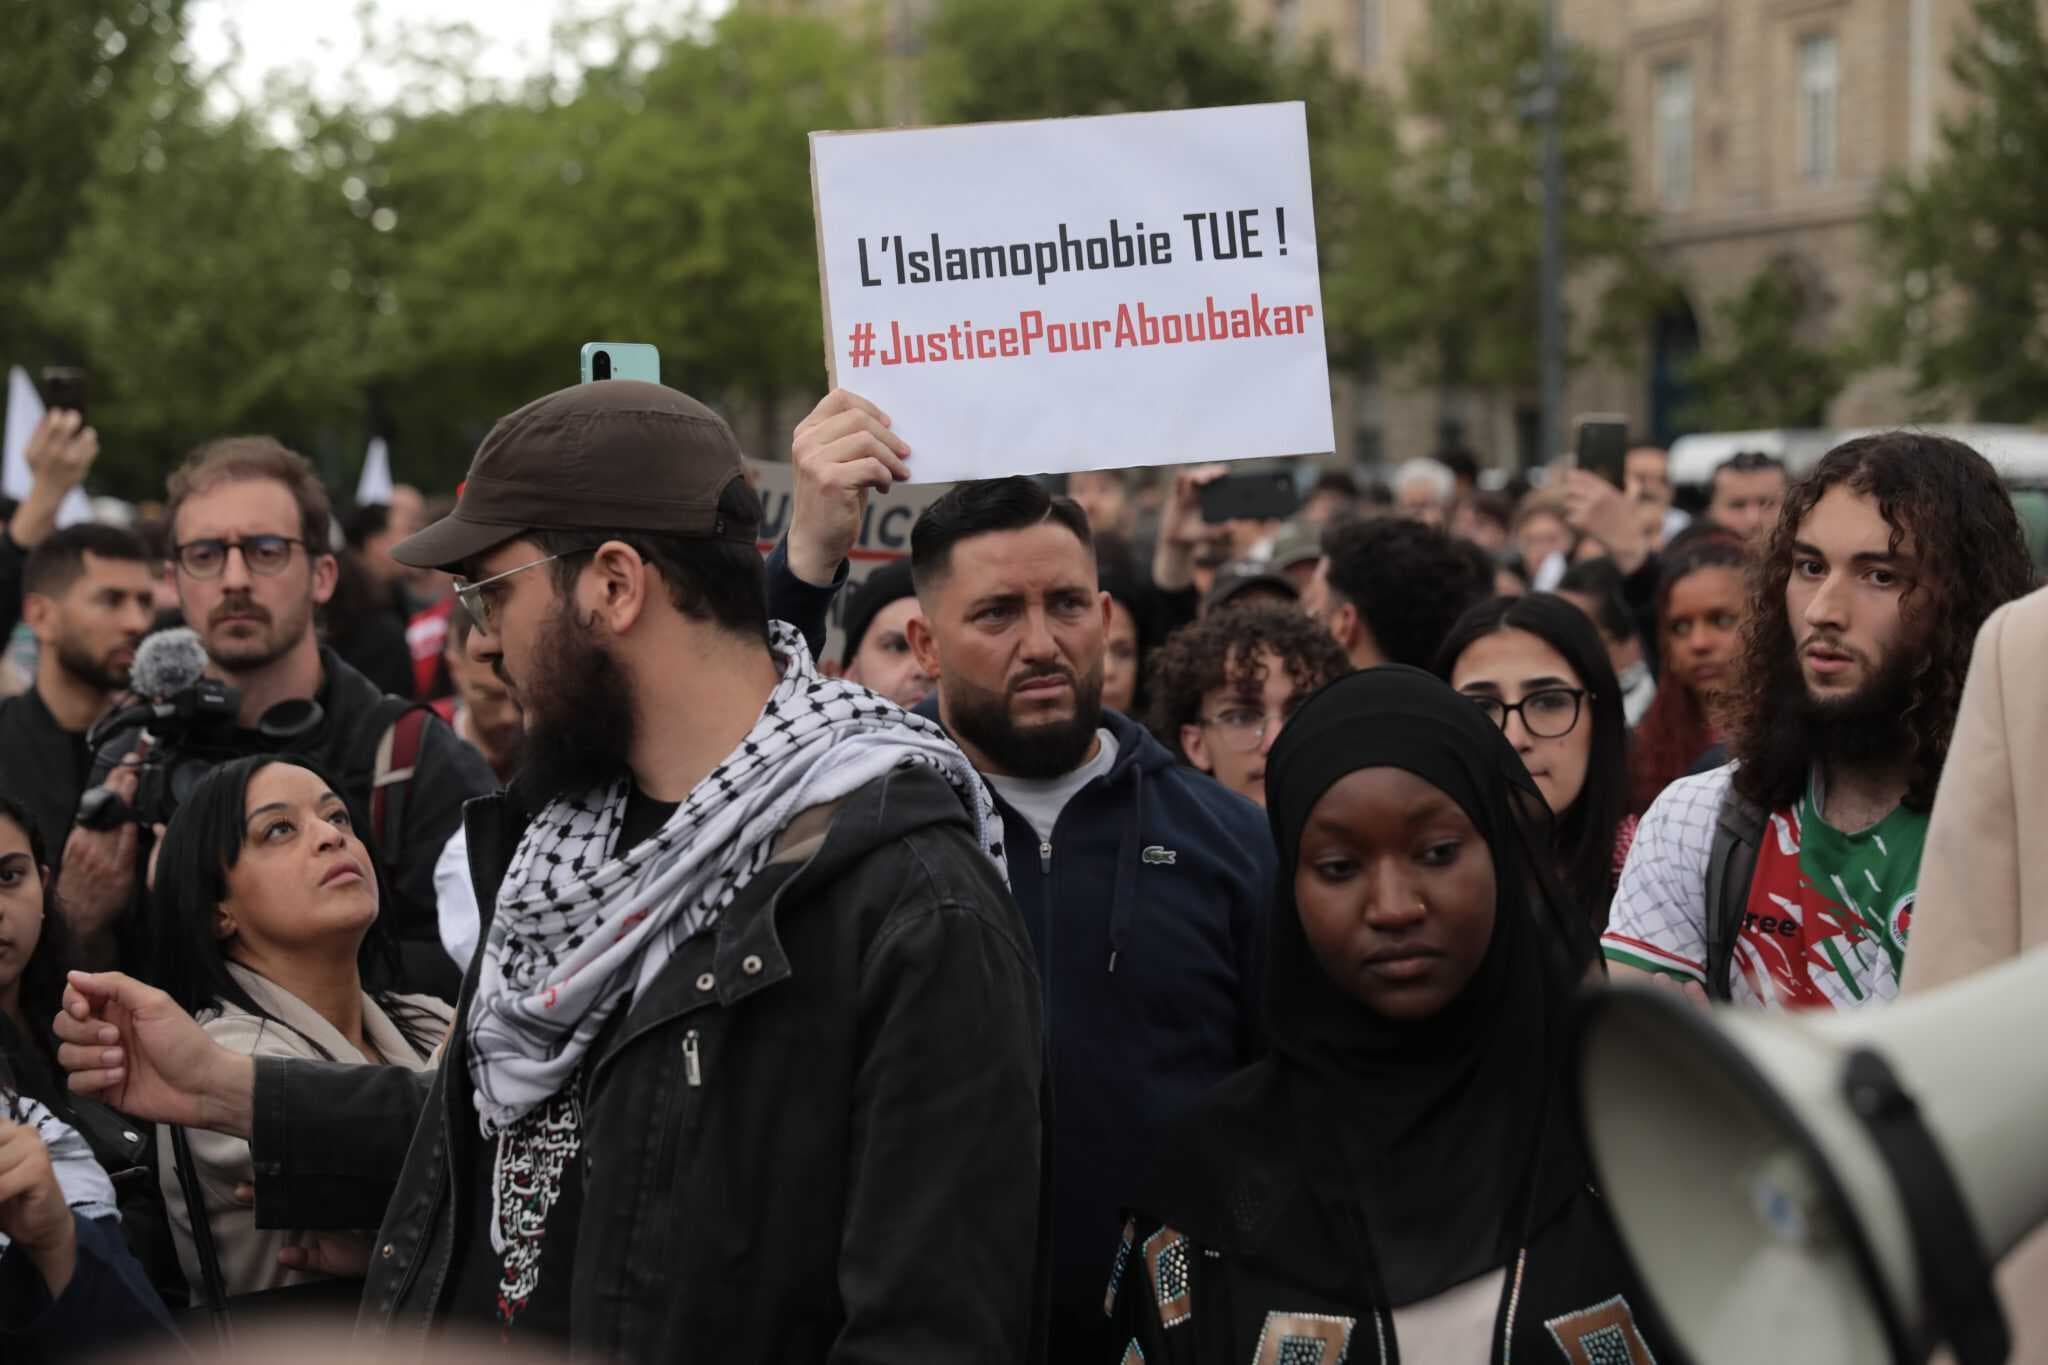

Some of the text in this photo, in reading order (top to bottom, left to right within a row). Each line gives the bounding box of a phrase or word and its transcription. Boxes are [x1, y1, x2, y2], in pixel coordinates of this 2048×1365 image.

[1184, 209, 1262, 261] TUE
[1276, 207, 1287, 255] !
[849, 293, 1313, 366] #JusticePourAboubakar
[1745, 911, 1797, 937] ree
